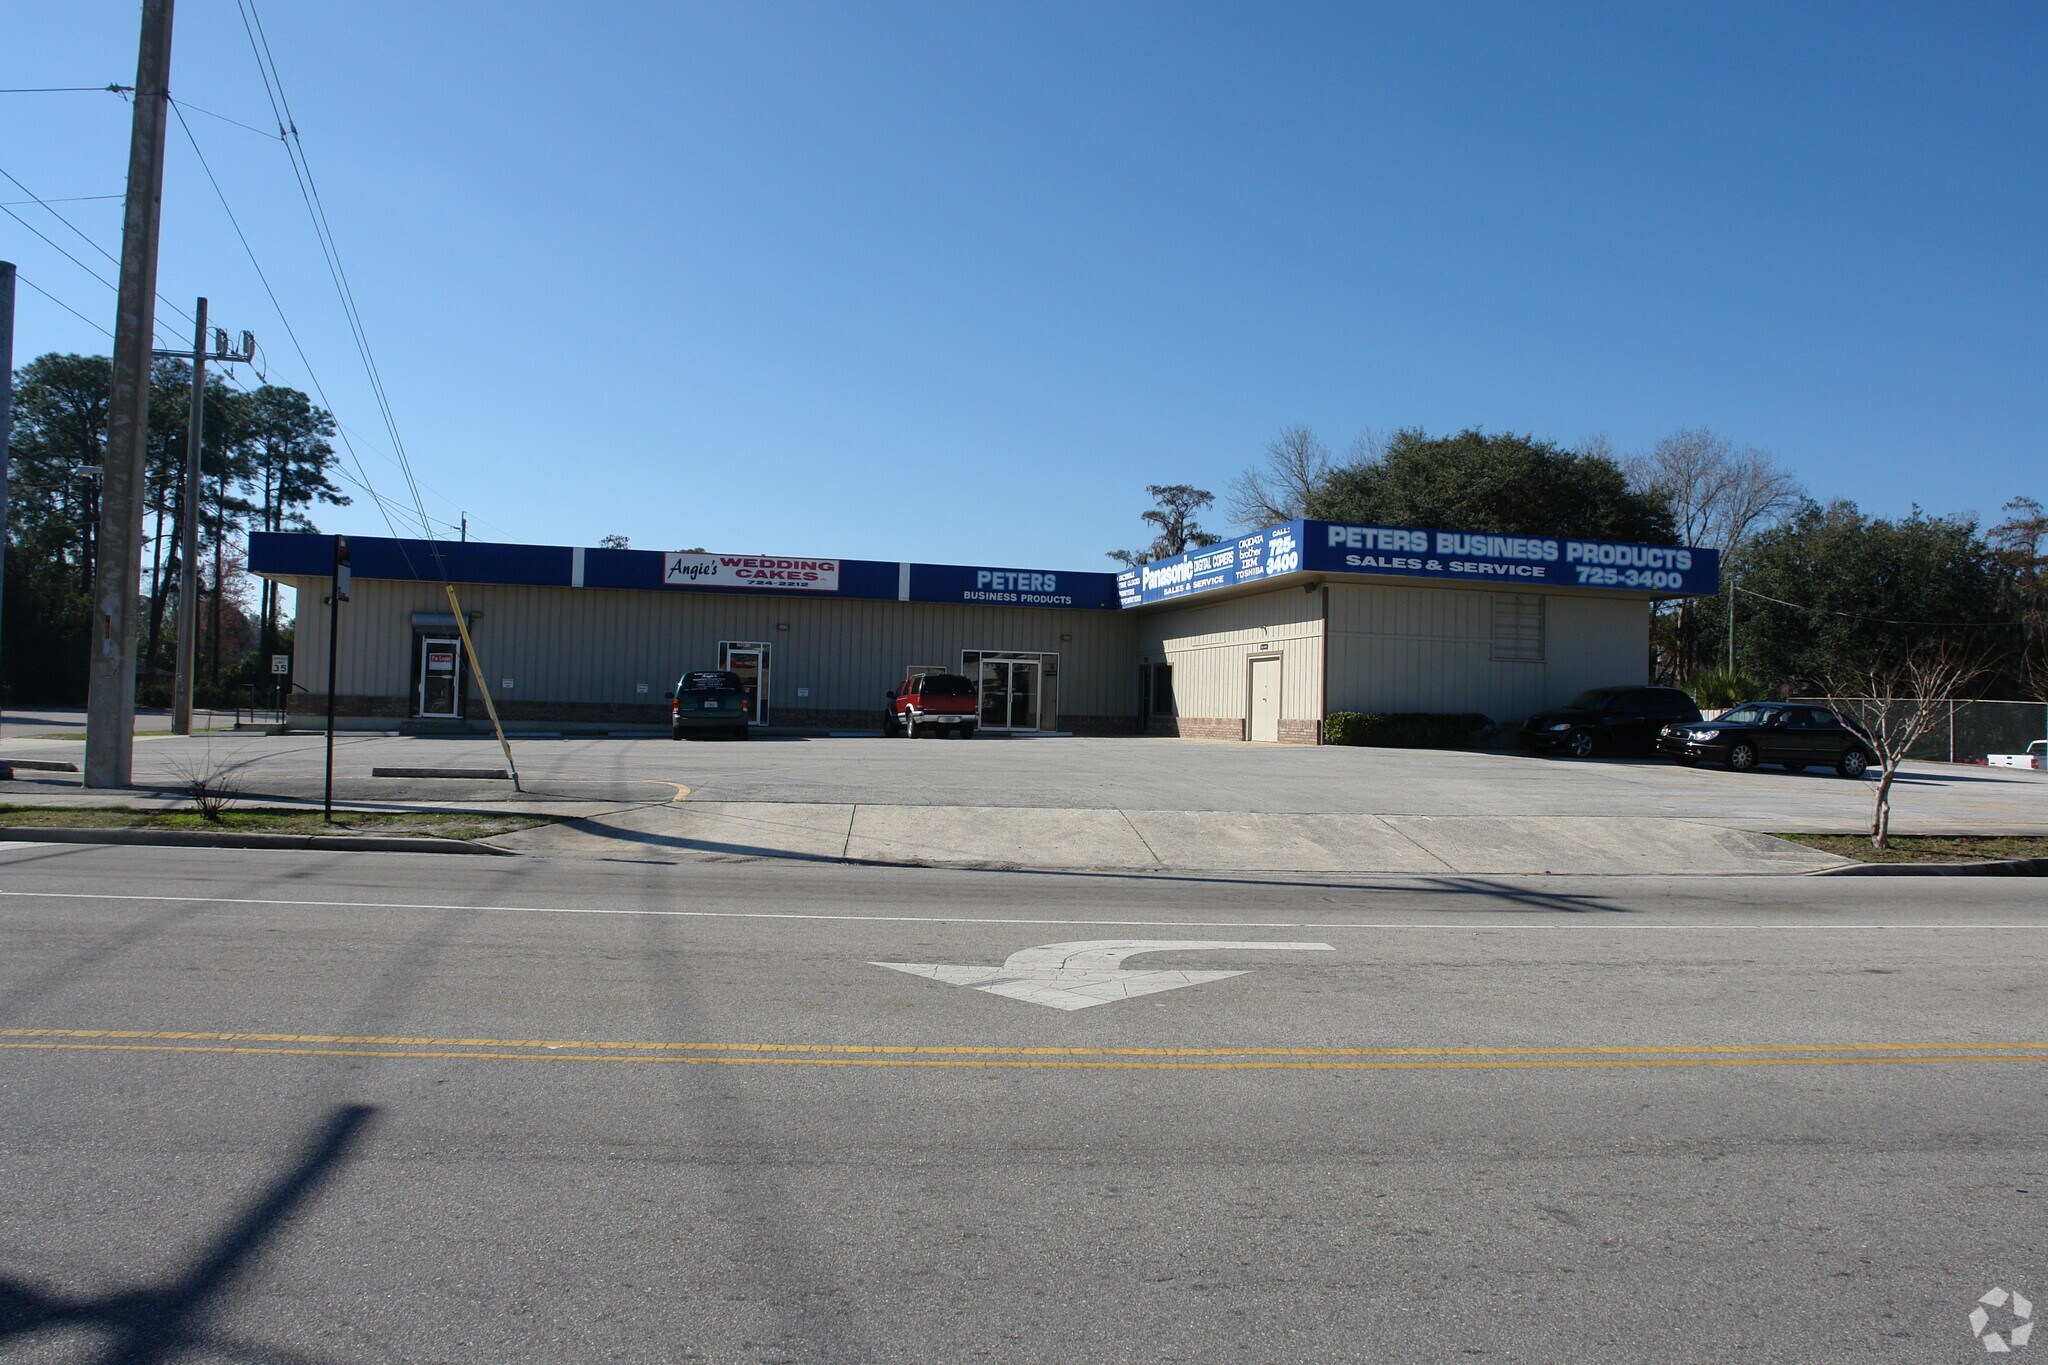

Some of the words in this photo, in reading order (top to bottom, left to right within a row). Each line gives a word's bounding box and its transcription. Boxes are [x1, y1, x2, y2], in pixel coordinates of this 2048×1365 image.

[1238, 535, 1264, 549] OKIDATA
[1328, 525, 1428, 553] PETERS
[1436, 532, 1559, 562] BUSINESS
[1566, 541, 1692, 571] PRODUCTS
[1194, 557, 1212, 573] DIGITAL
[1212, 551, 1234, 568] COPIERS
[1240, 547, 1261, 560] brother
[1242, 557, 1258, 569] IBM
[1266, 551, 1298, 574] 3400
[667, 558, 718, 580] Angie's
[720, 557, 834, 572] WEDDING
[735, 569, 819, 581] CAKES
[1142, 555, 1194, 591] Panasonic
[1236, 566, 1264, 579] TOSHIBA
[1346, 555, 1423, 570] SALES
[1425, 559, 1443, 571] &
[1449, 561, 1546, 577] SERVICE
[977, 570, 1056, 592] PETERS
[1164, 585, 1184, 596] SALES
[1193, 575, 1224, 589] SERVICE
[1576, 566, 1683, 589] 725-3400
[963, 591, 1017, 602] BUSINESS
[1021, 594, 1072, 605] PRODUCTS
[273, 664, 287, 672] 35
